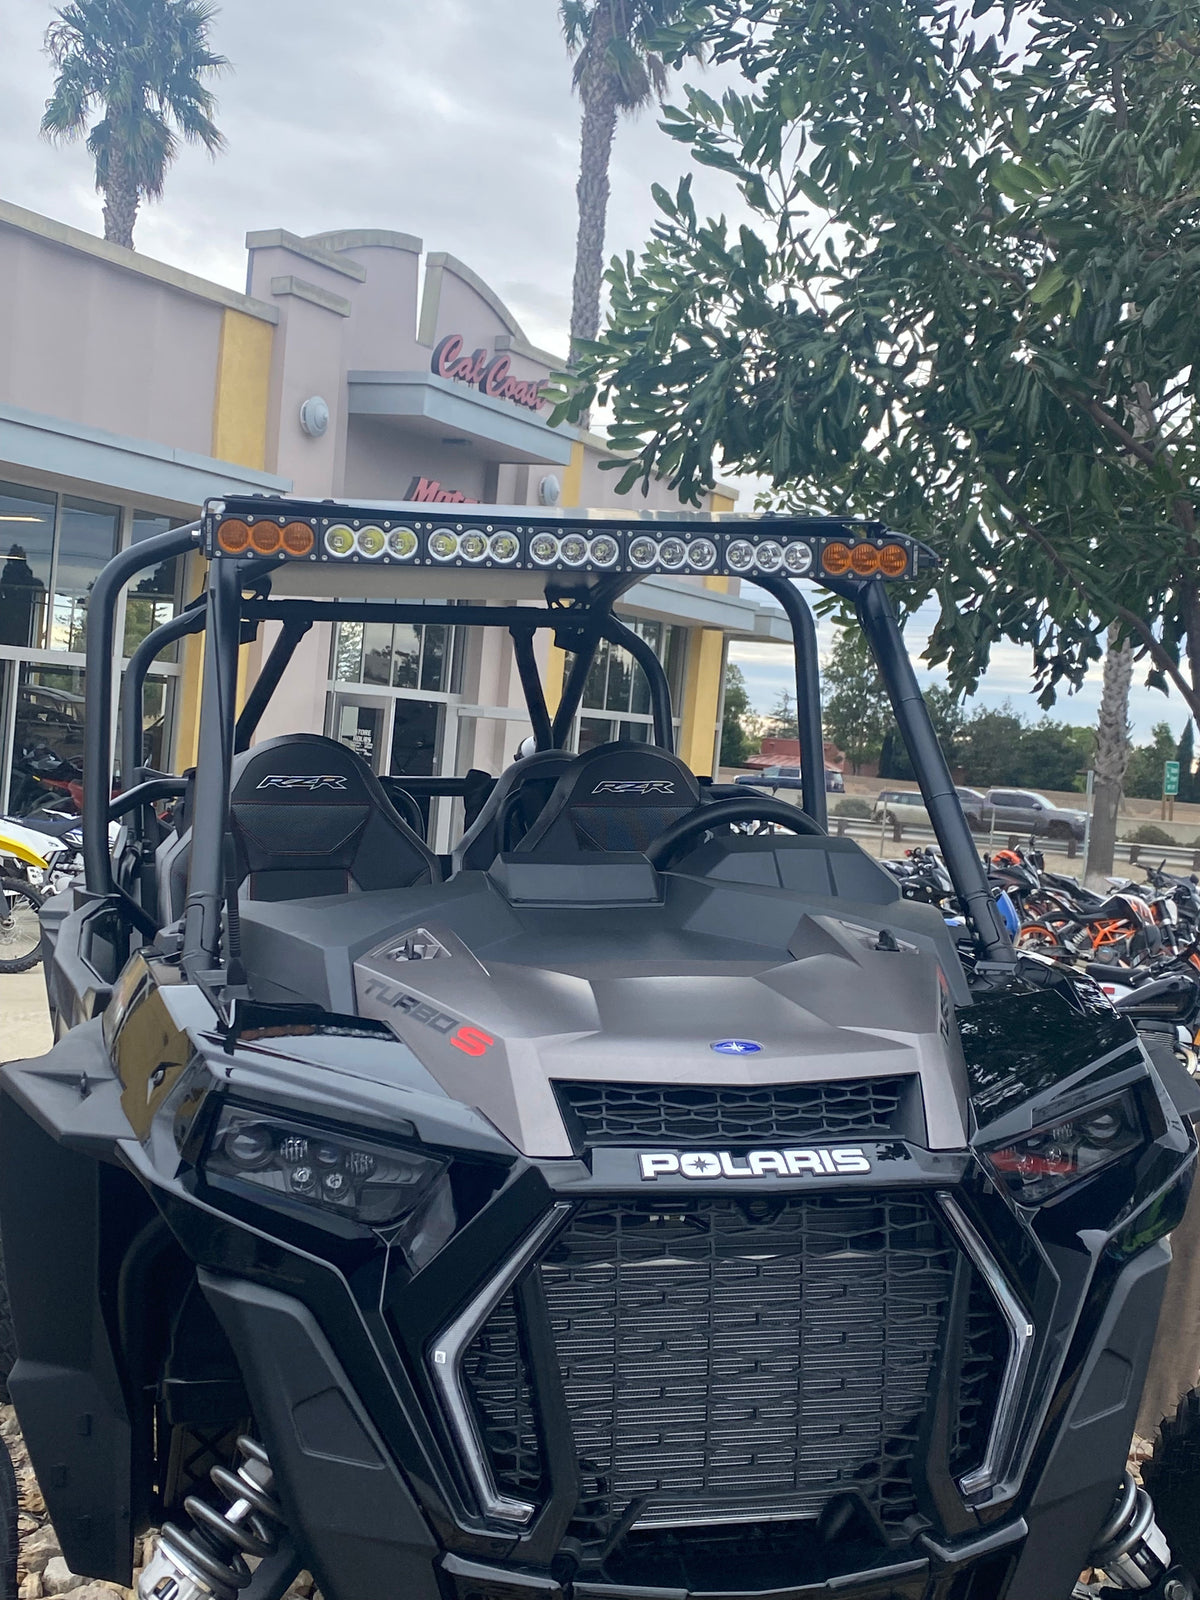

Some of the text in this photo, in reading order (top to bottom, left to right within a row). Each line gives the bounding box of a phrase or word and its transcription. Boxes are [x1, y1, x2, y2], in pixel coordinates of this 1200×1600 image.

[433, 334, 487, 384] Cal
[256, 775, 348, 791] RZR
[591, 780, 675, 794] RZR
[364, 978, 495, 1057] TURBO S
[639, 1148, 872, 1180] POLARIS
